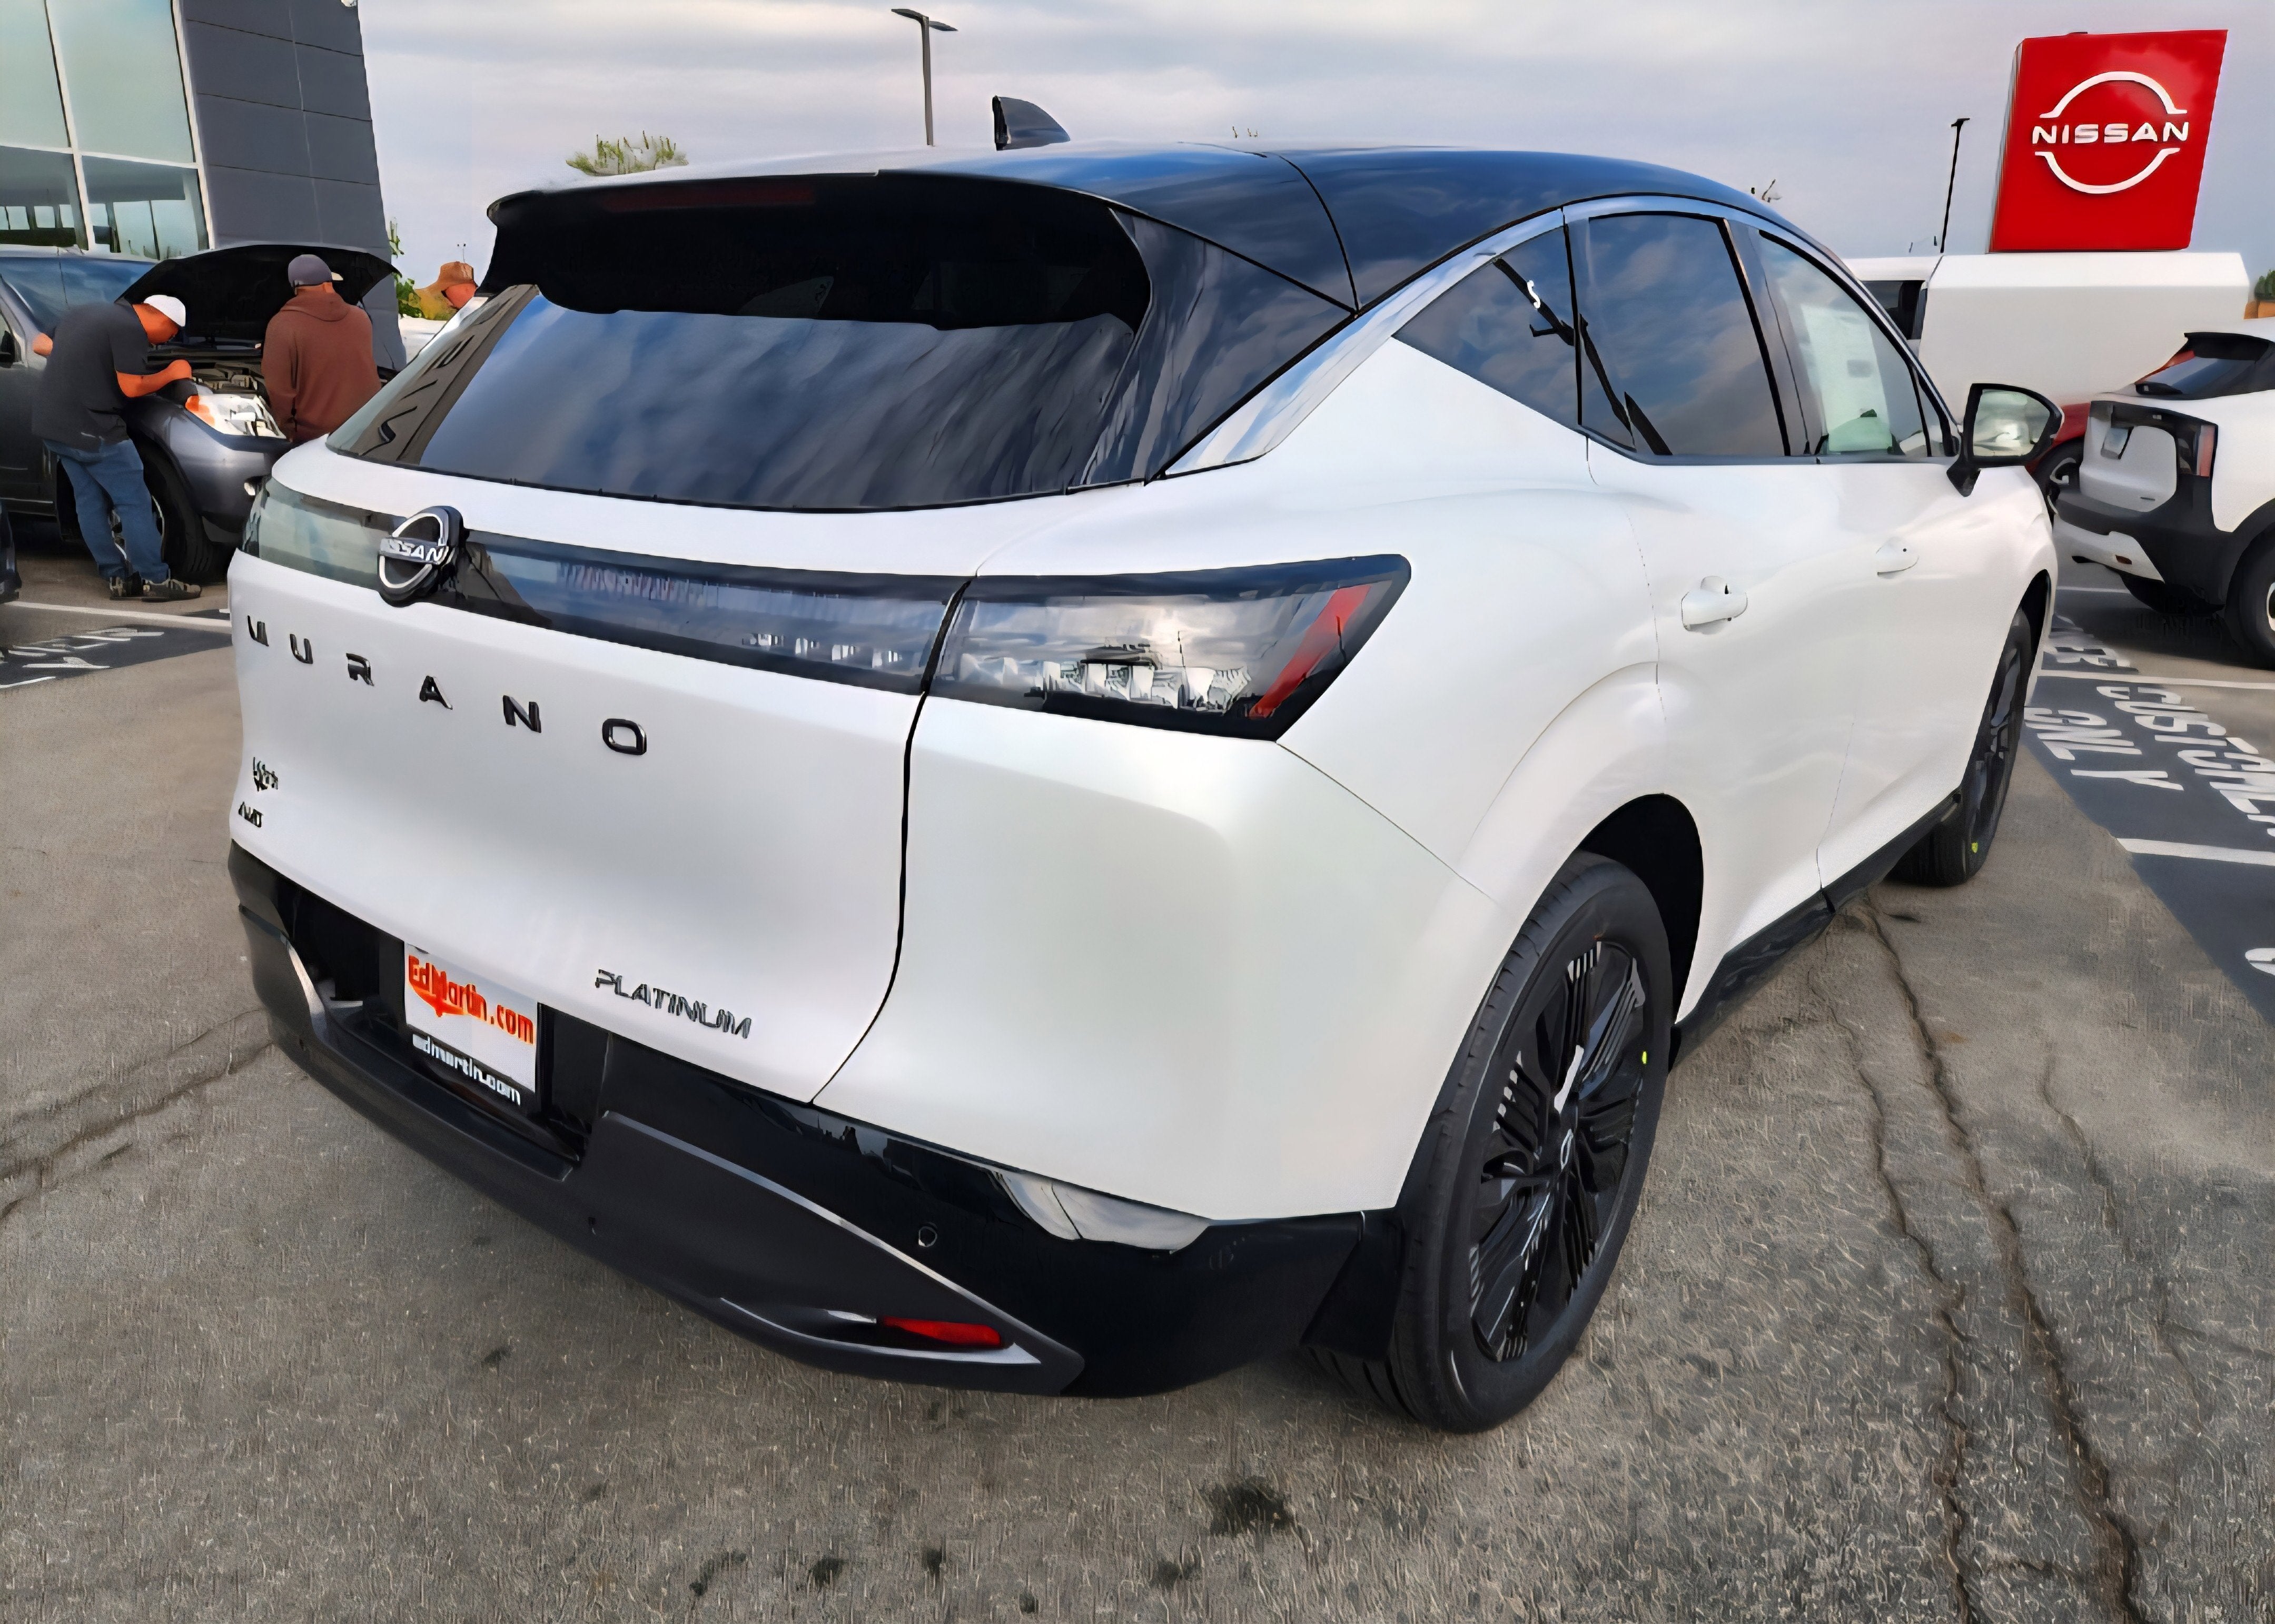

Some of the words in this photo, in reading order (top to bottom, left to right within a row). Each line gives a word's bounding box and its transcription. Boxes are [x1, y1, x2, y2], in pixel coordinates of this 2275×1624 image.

[2032, 121, 2189, 144] NISSAN
[408, 954, 533, 1045] EdMartin.com
[595, 968, 752, 1039] PLATINUM
